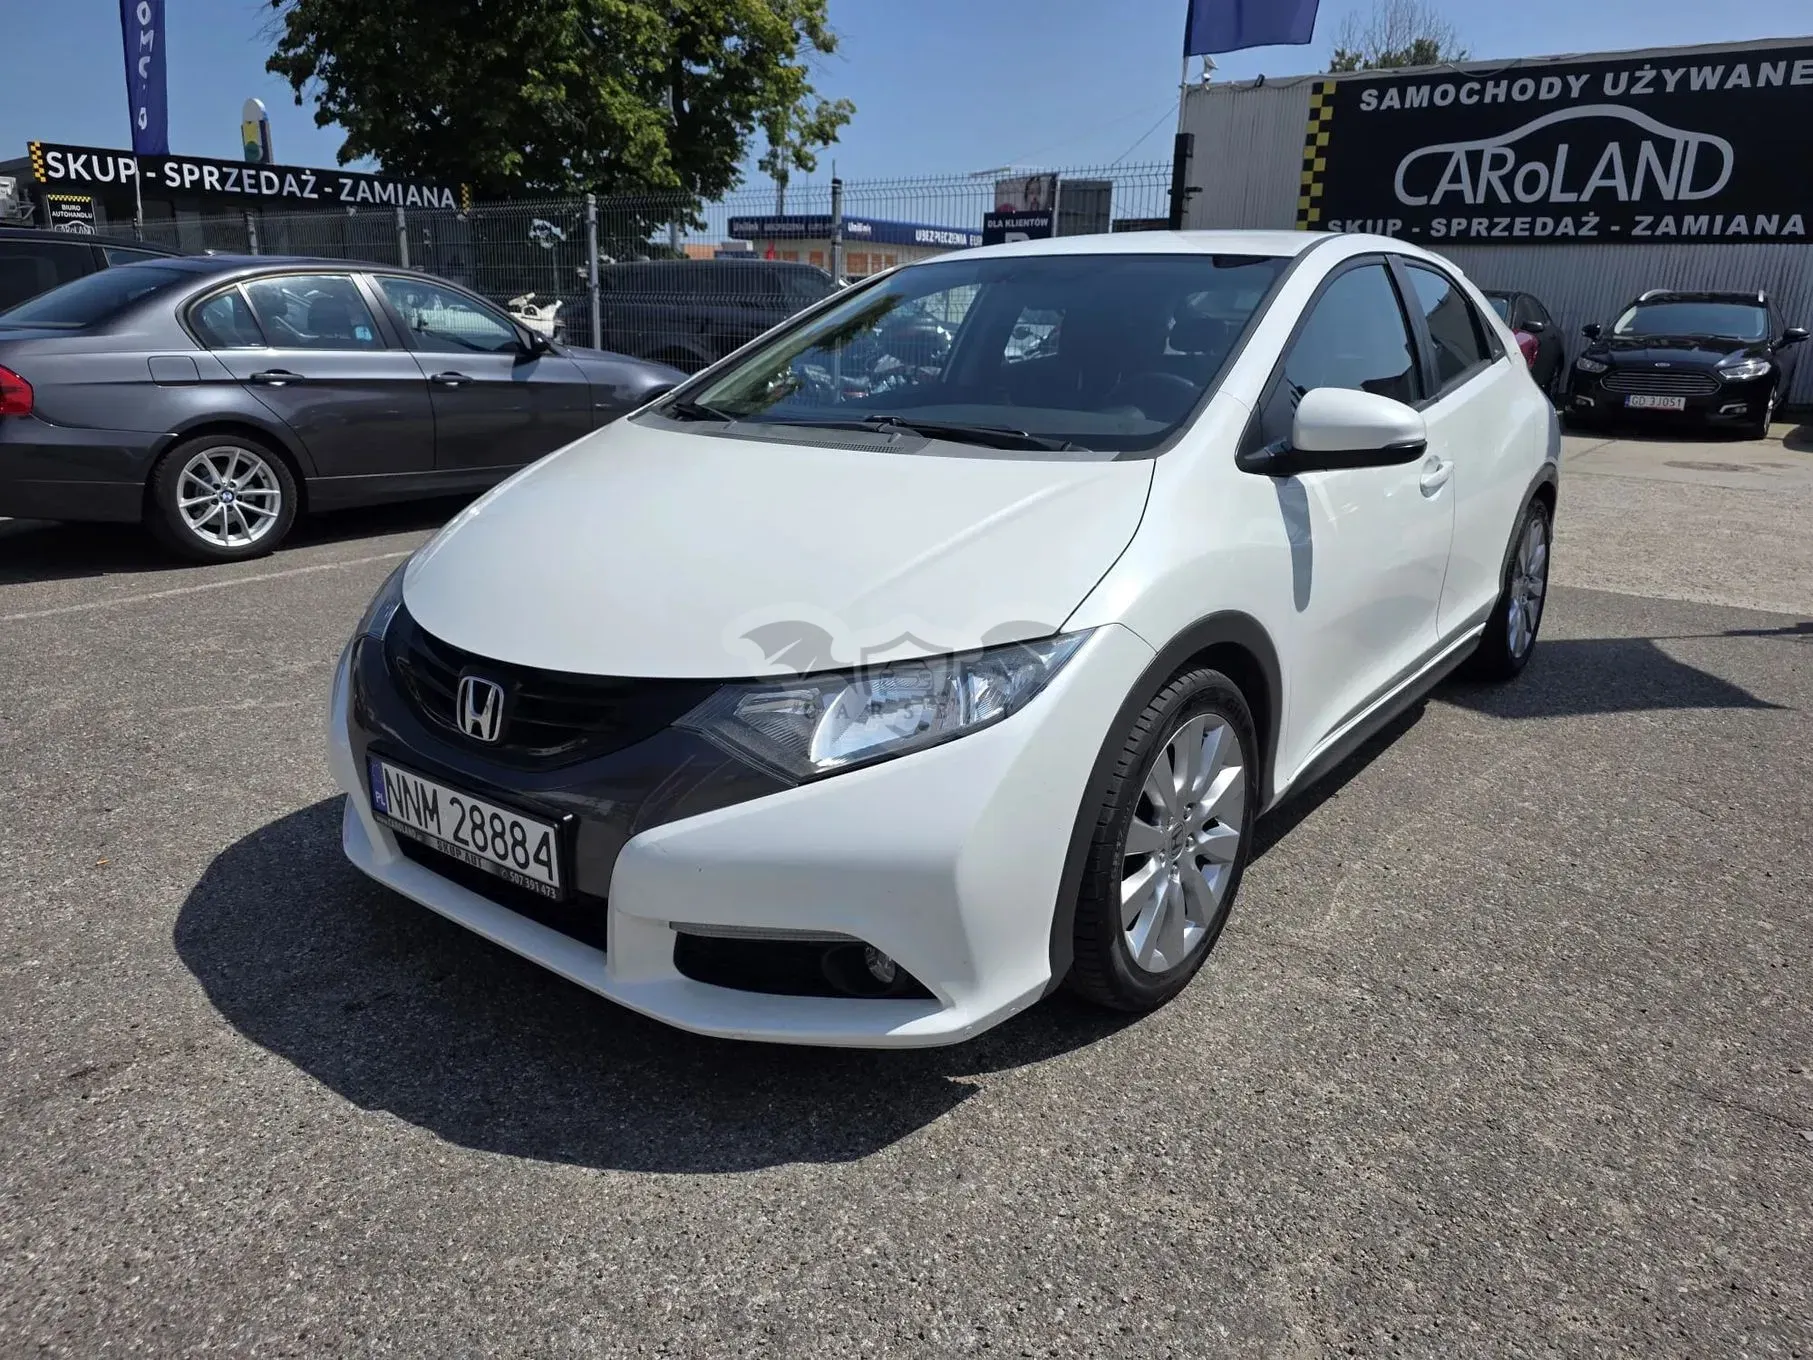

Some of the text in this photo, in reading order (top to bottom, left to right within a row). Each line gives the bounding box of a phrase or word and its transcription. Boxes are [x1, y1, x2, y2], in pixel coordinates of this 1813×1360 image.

[1359, 59, 1813, 112] SAMOCHODY UŻYWANE
[45, 151, 137, 184] SKUP
[164, 162, 319, 199] SPRZEDAŻ
[339, 178, 457, 210] ZAMIANA
[52, 210, 93, 219] AUTOHANDLU
[61, 204, 81, 212] BIURO
[987, 217, 1048, 228] DLA KLIENTÓW
[1327, 219, 1402, 237] SKUP
[1430, 212, 1600, 238] SPRZEDAŻ
[1632, 214, 1806, 236] ZAMIANA
[375, 793, 386, 807] PL
[384, 768, 555, 881] NNM 28884
[510, 871, 524, 886] 507
